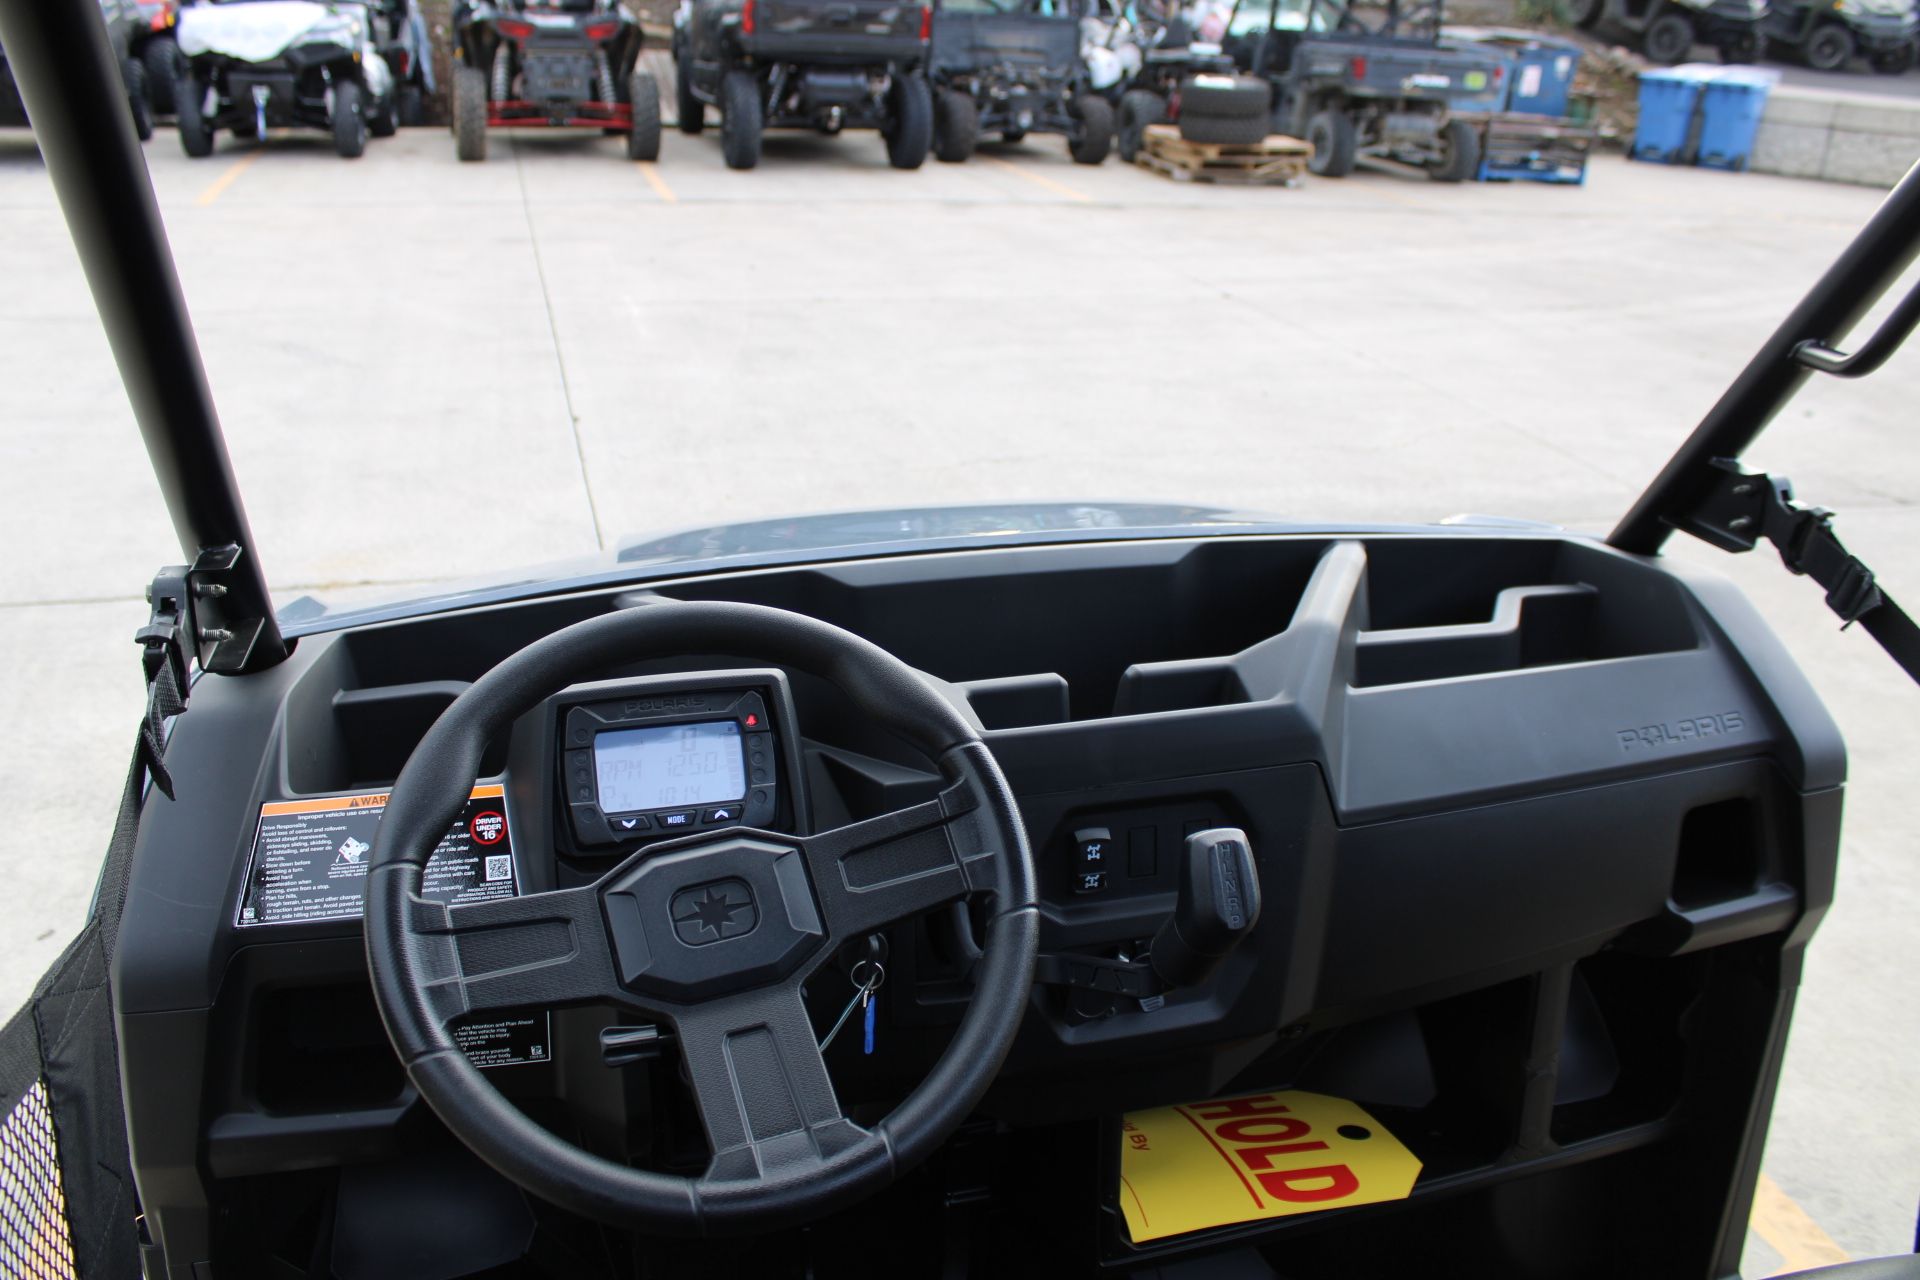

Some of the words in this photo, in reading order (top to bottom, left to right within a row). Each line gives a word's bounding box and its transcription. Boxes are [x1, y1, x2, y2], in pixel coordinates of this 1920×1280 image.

[625, 697, 705, 713] POLARIS
[1616, 710, 1745, 751] POLARIS
[600, 759, 642, 780] RPM
[476, 816, 502, 825] DRIVER
[667, 815, 686, 826] MODE
[482, 830, 496, 840] 16
[1130, 1134, 1151, 1150] By
[1188, 1094, 1360, 1204] HOLD
